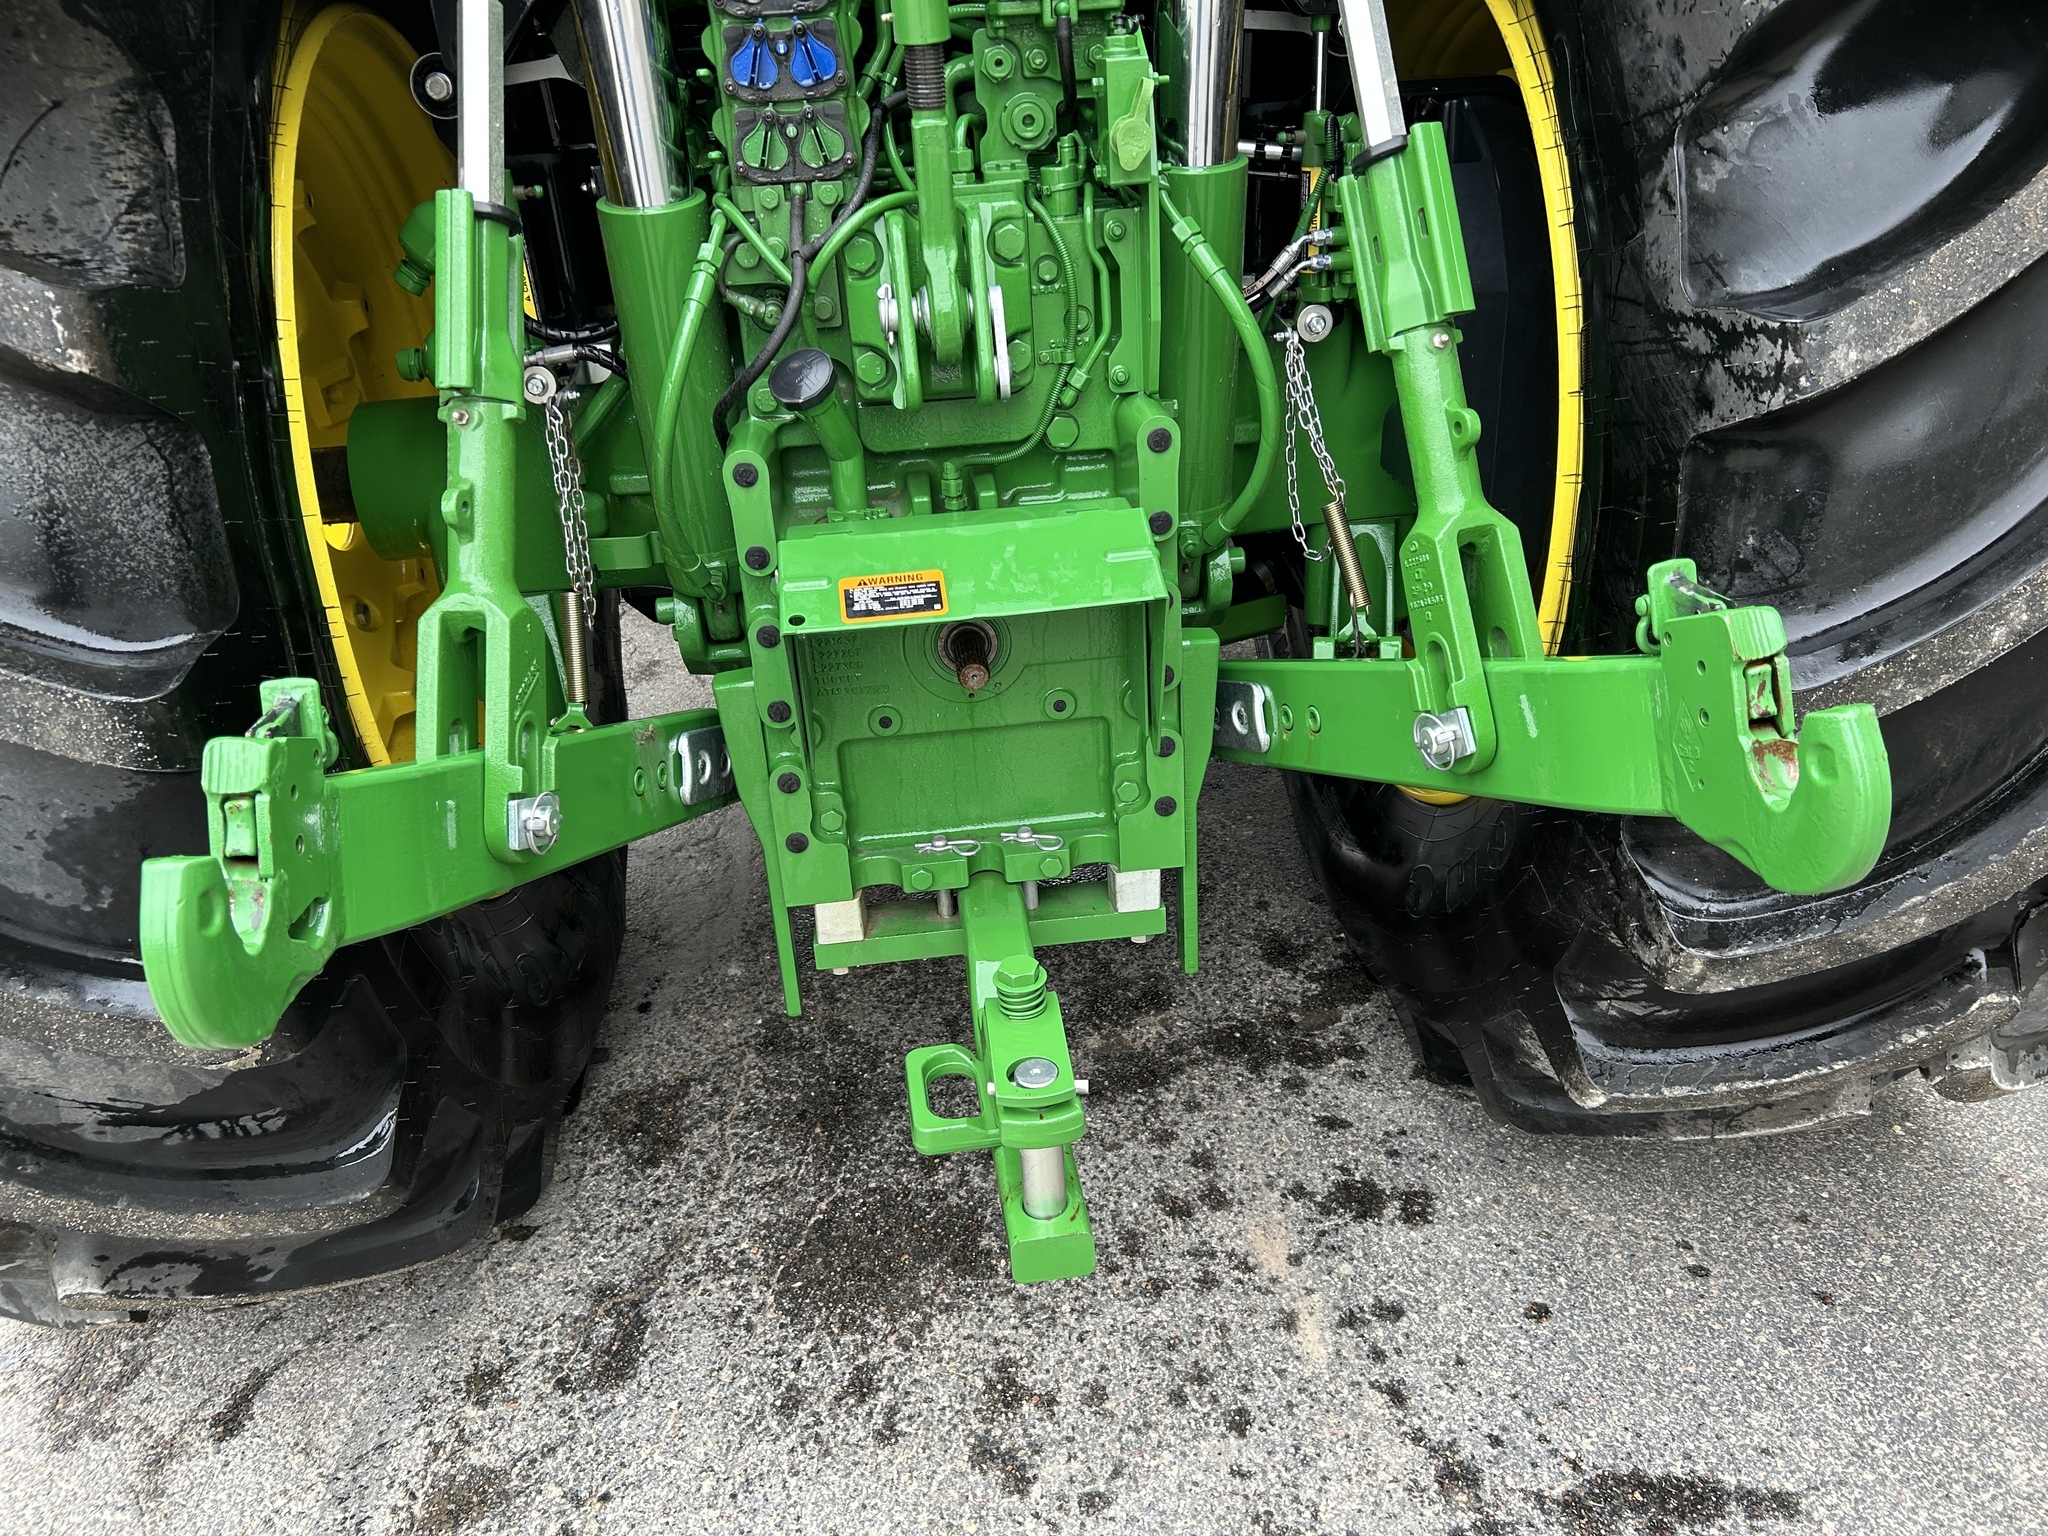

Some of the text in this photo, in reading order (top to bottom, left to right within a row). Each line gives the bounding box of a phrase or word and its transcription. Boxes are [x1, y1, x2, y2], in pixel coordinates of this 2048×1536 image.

[1031, 284, 1068, 296] BRAKE
[868, 573, 923, 586] WARNING
[814, 673, 861, 686] TURKEY
